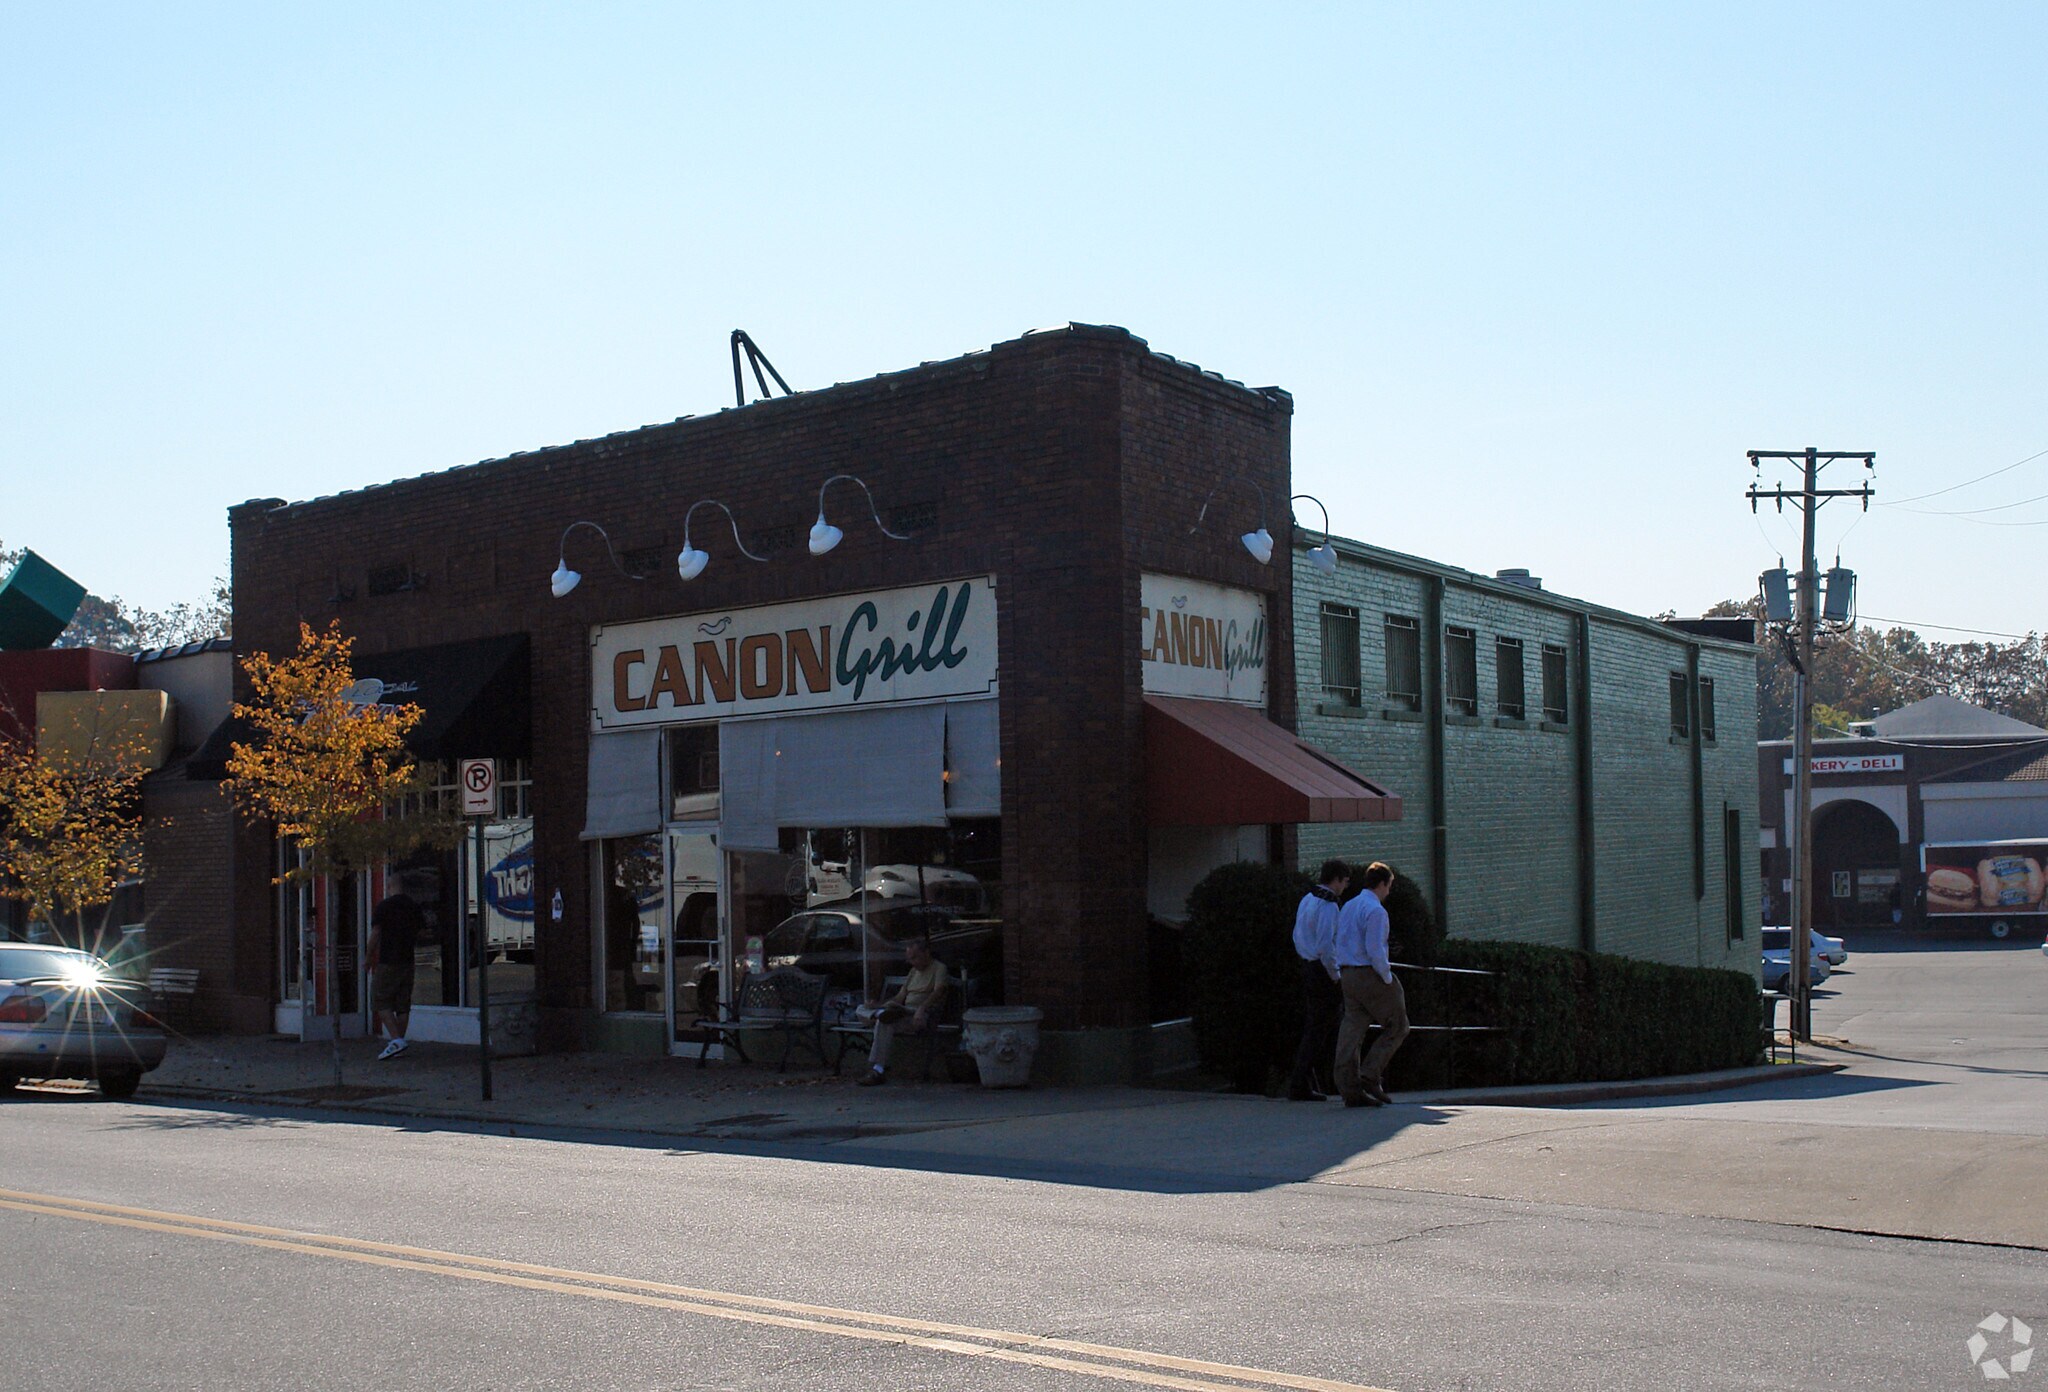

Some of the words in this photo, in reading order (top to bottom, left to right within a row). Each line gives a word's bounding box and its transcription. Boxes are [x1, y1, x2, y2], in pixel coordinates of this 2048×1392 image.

[836, 581, 971, 701] Grill
[1225, 617, 1264, 681] Grill
[472, 768, 487, 788] P
[1811, 760, 1848, 770] KERY
[1861, 758, 1896, 769] DELI
